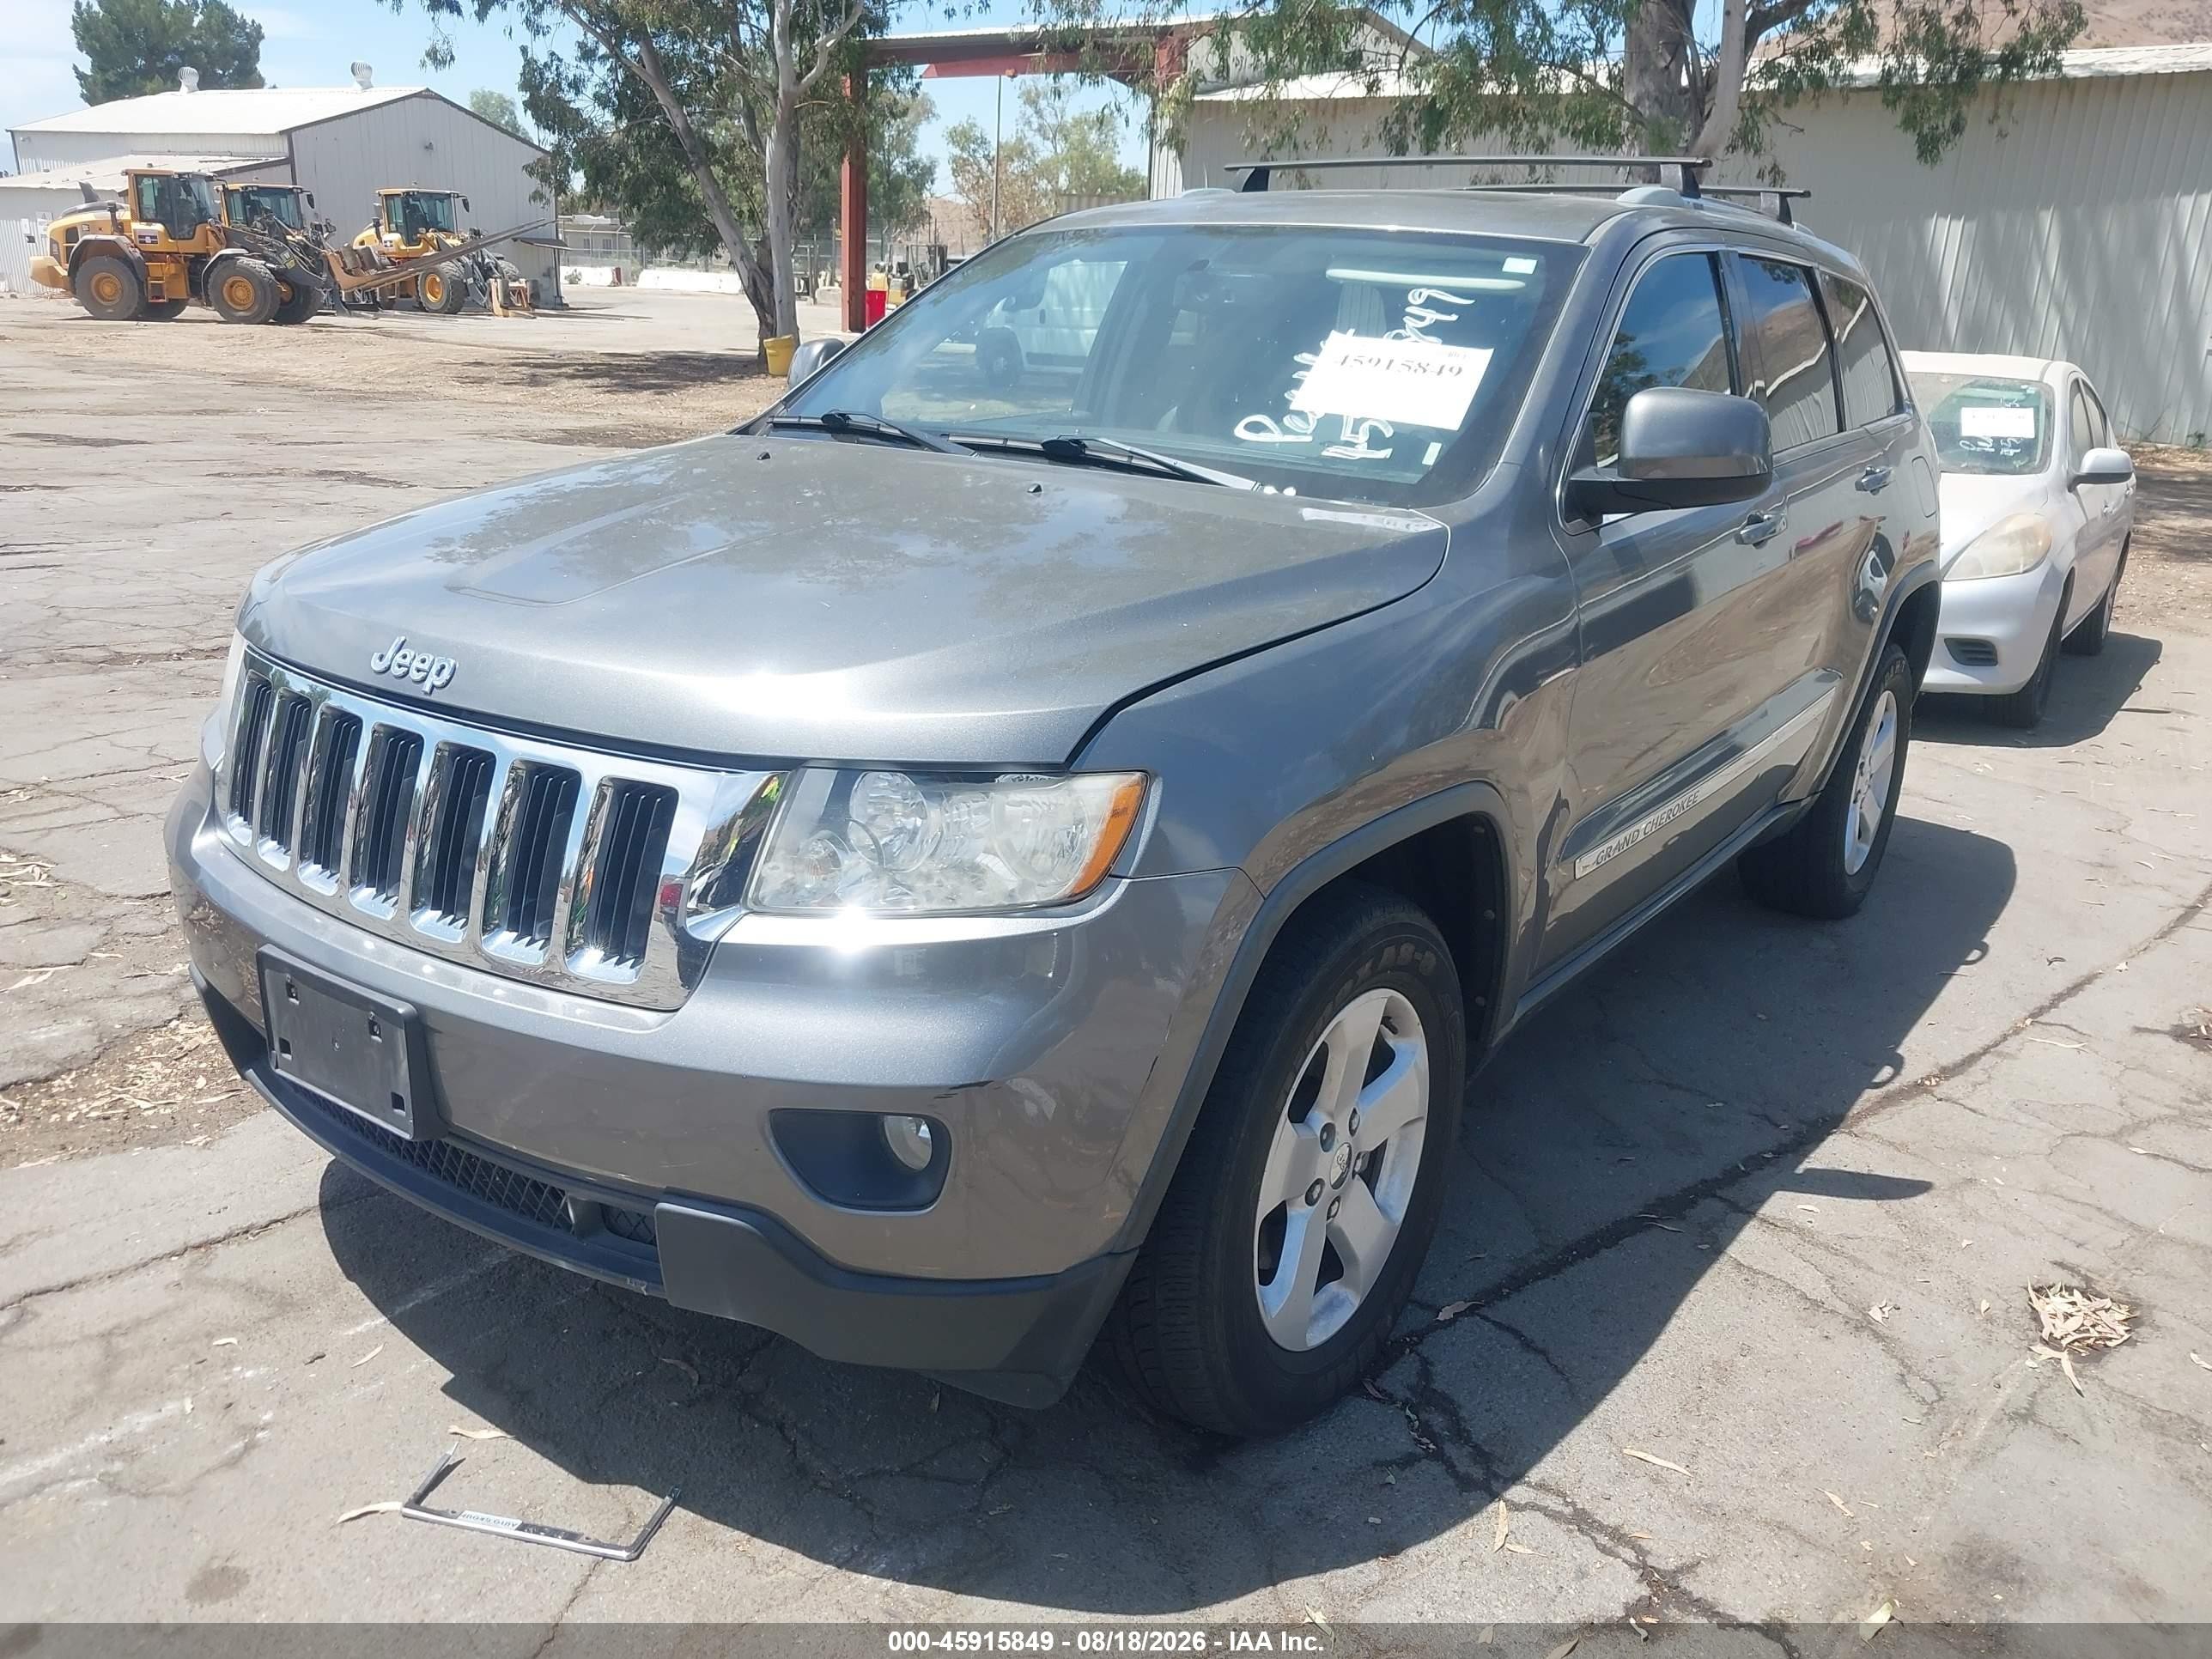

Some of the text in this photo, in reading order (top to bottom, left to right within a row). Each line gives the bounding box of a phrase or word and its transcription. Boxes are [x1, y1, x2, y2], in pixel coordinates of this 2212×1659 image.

[1334, 353, 1464, 378] 45915849
[371, 635, 458, 695] Jeep
[1594, 790, 1700, 866] GRAND CHEROKEE
